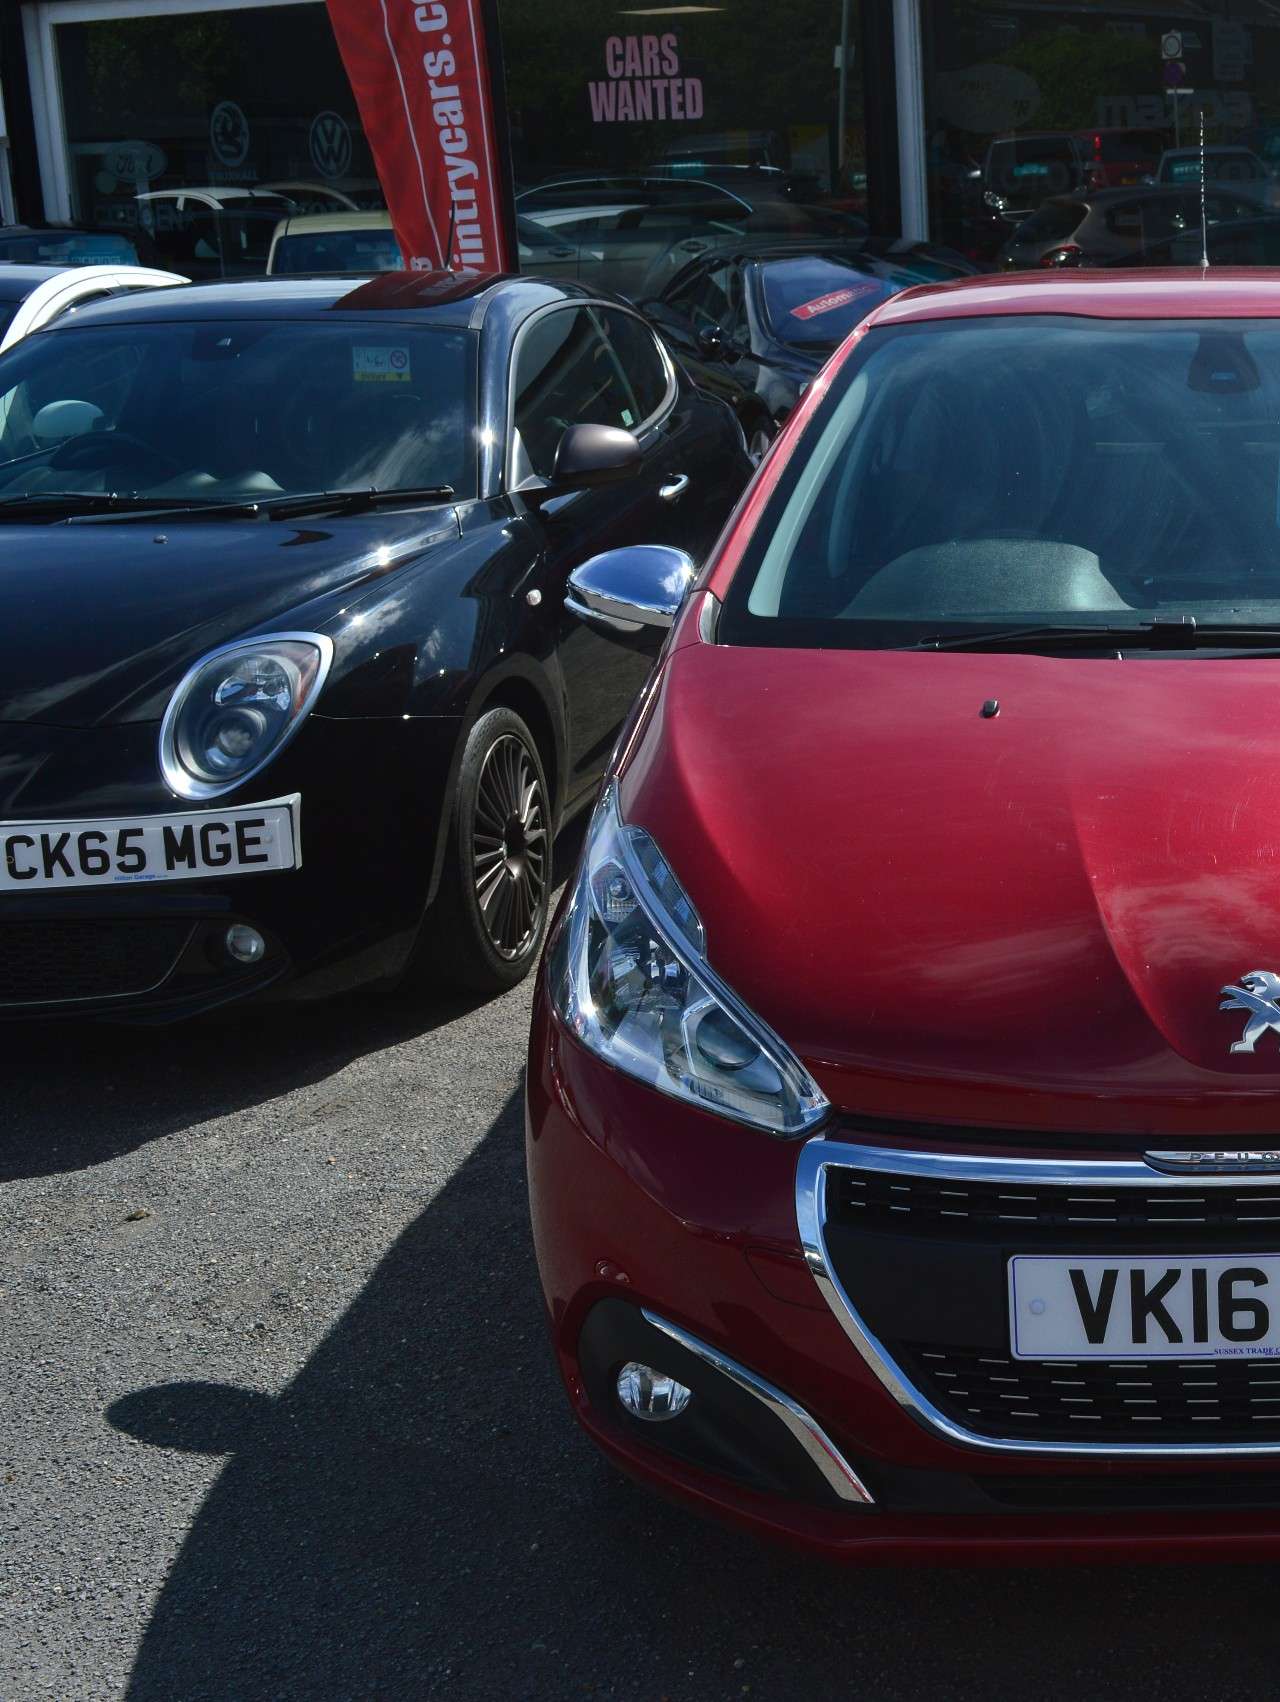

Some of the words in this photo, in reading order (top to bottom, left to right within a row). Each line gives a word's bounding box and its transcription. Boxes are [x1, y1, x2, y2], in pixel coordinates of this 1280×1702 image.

[605, 33, 679, 78] CARS
[588, 78, 704, 122] WANTED
[411, 0, 485, 274] intrycars.c
[4, 827, 147, 880] CK65
[162, 818, 269, 871] MGE
[1068, 1267, 1270, 1345] VK16
[1214, 1347, 1245, 1355] SUSSEX
